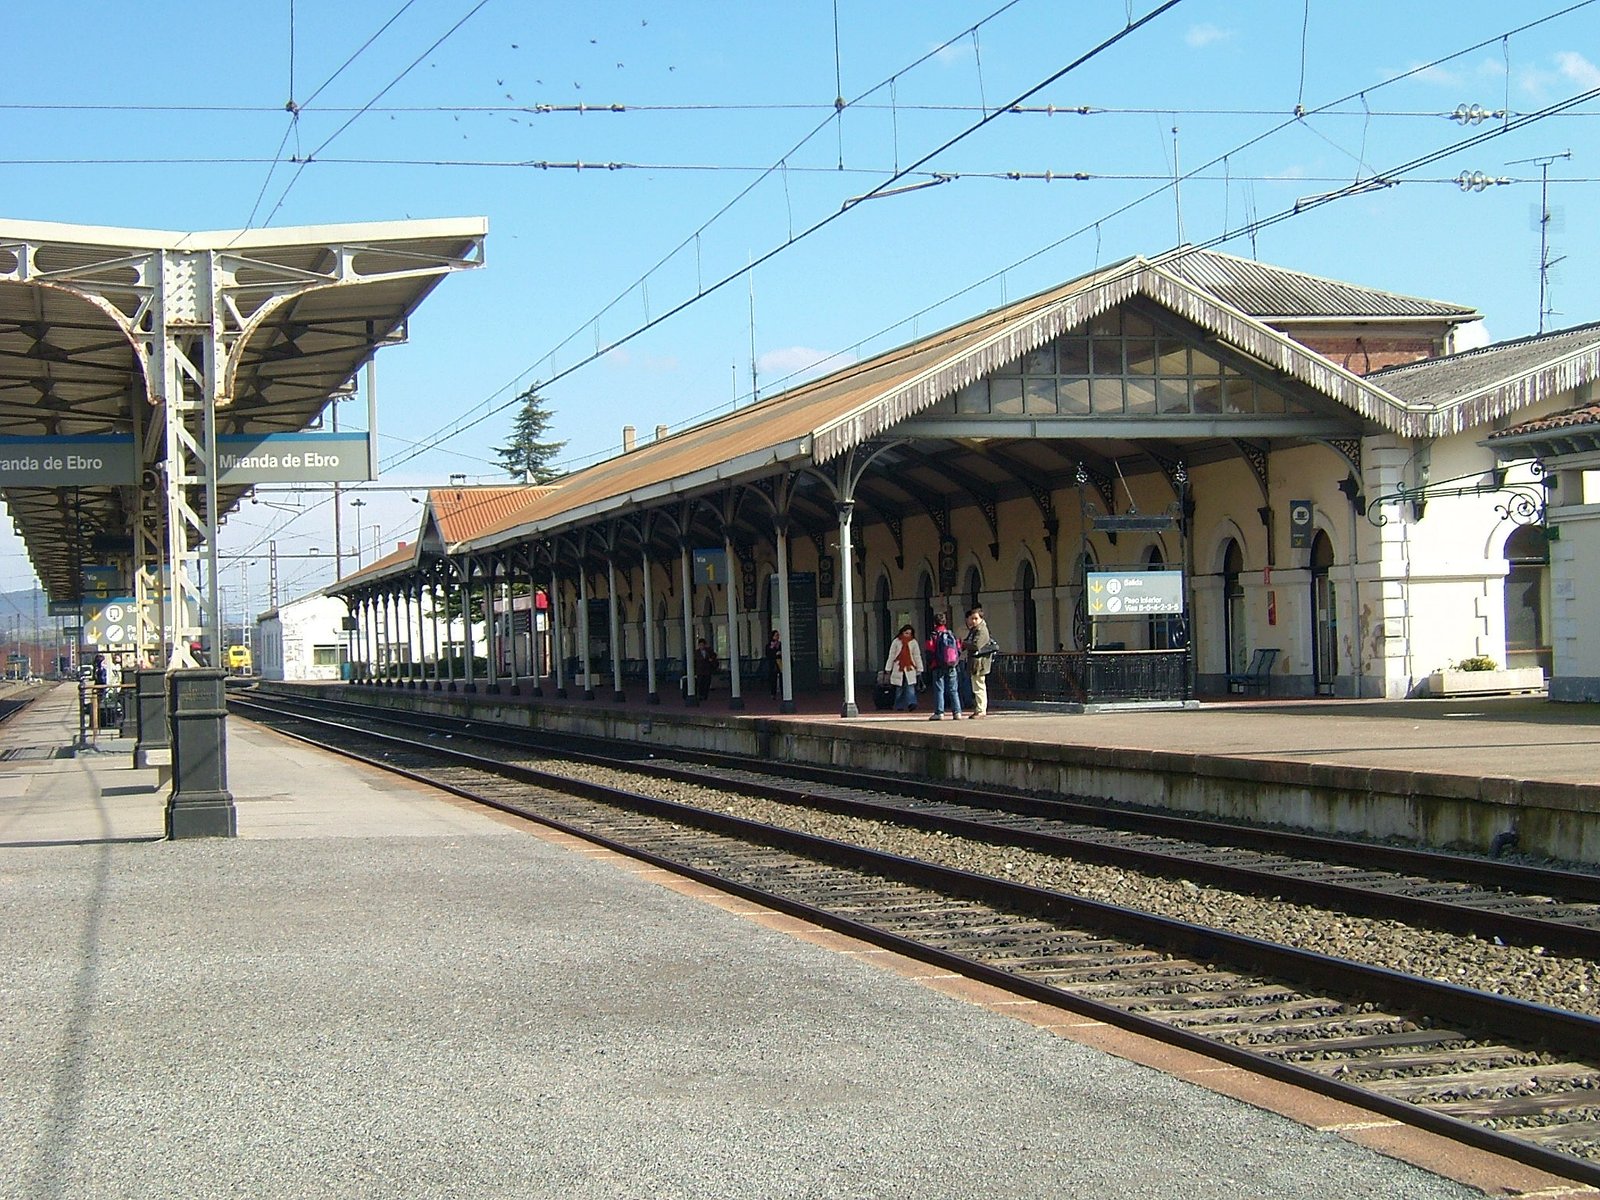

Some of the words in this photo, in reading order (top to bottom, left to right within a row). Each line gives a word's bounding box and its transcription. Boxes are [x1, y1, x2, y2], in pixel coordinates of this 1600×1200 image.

[43, 456, 63, 470] de
[67, 455, 103, 470] Ebro
[219, 453, 278, 468] Miranda
[282, 453, 301, 468] de
[304, 452, 340, 467] Ebro
[706, 563, 714, 581] 1
[96, 582, 108, 599] 5
